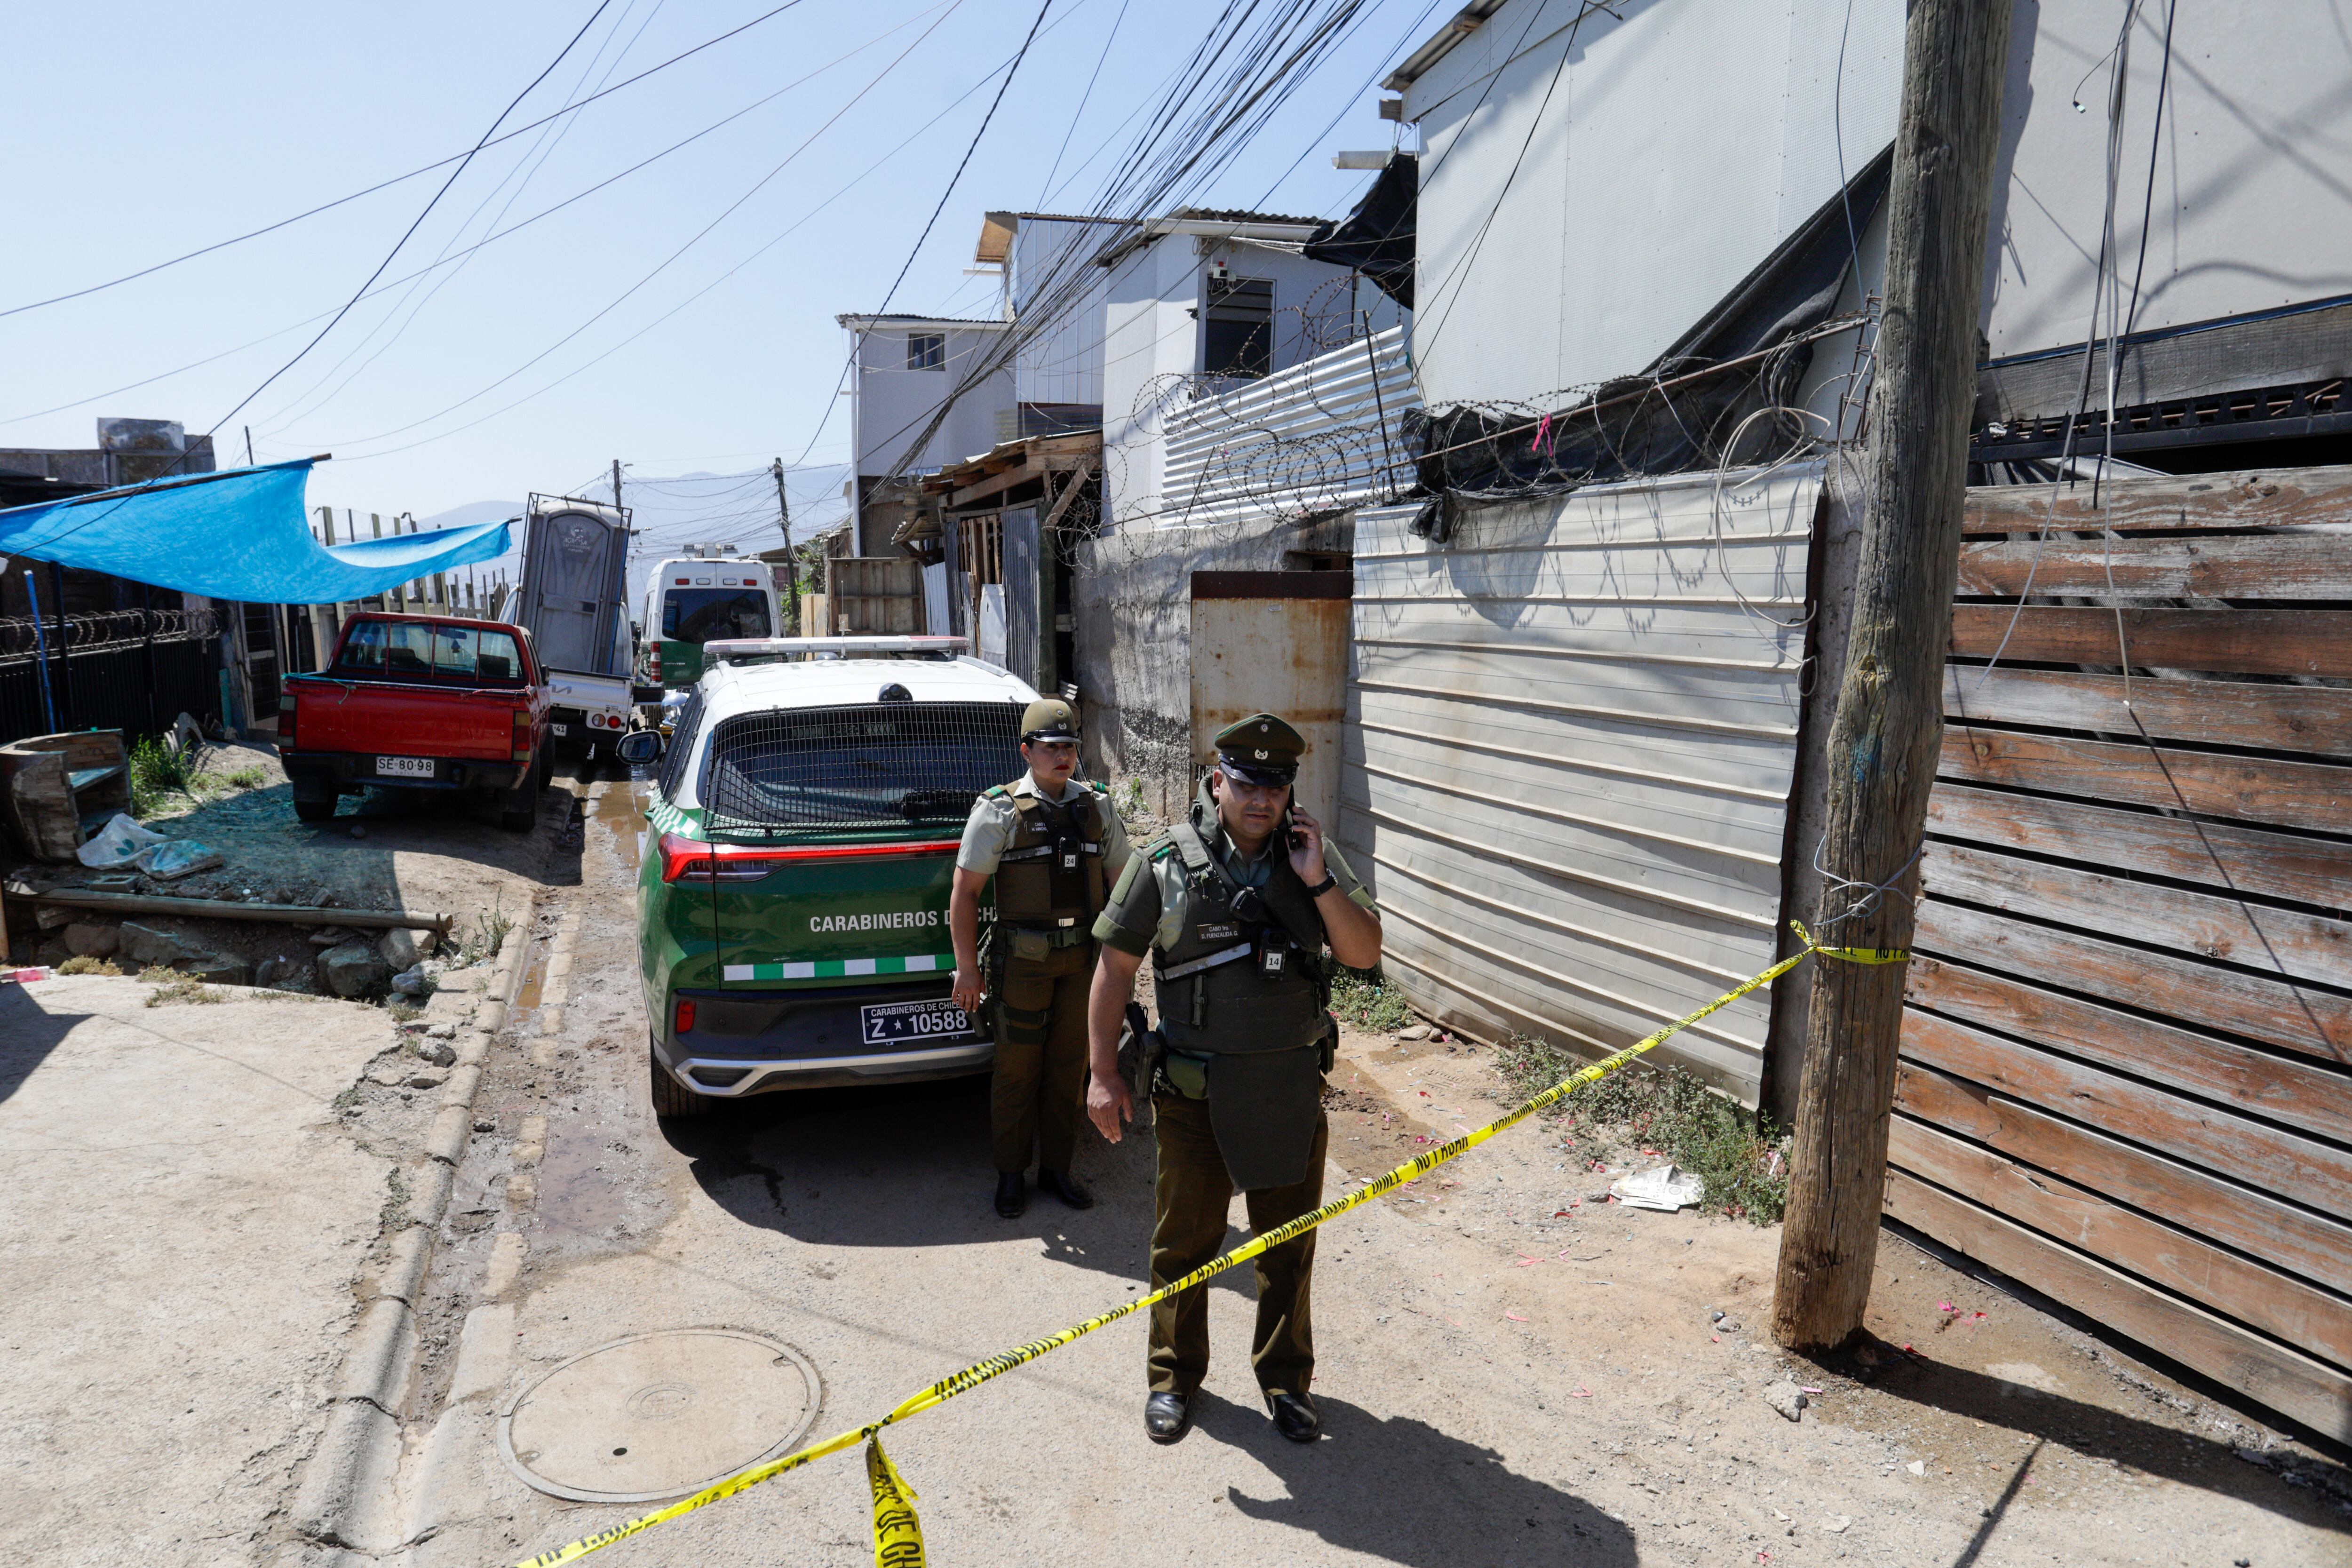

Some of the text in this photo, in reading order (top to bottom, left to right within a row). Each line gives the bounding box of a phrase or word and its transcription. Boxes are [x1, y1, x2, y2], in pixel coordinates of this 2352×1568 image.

[810, 910, 938, 932] CARABINEROS
[1268, 957, 1279, 966] 14
[871, 1004, 925, 1017] CARABINEROS
[927, 1003, 937, 1011] DE
[871, 1010, 967, 1038] Z 10588
